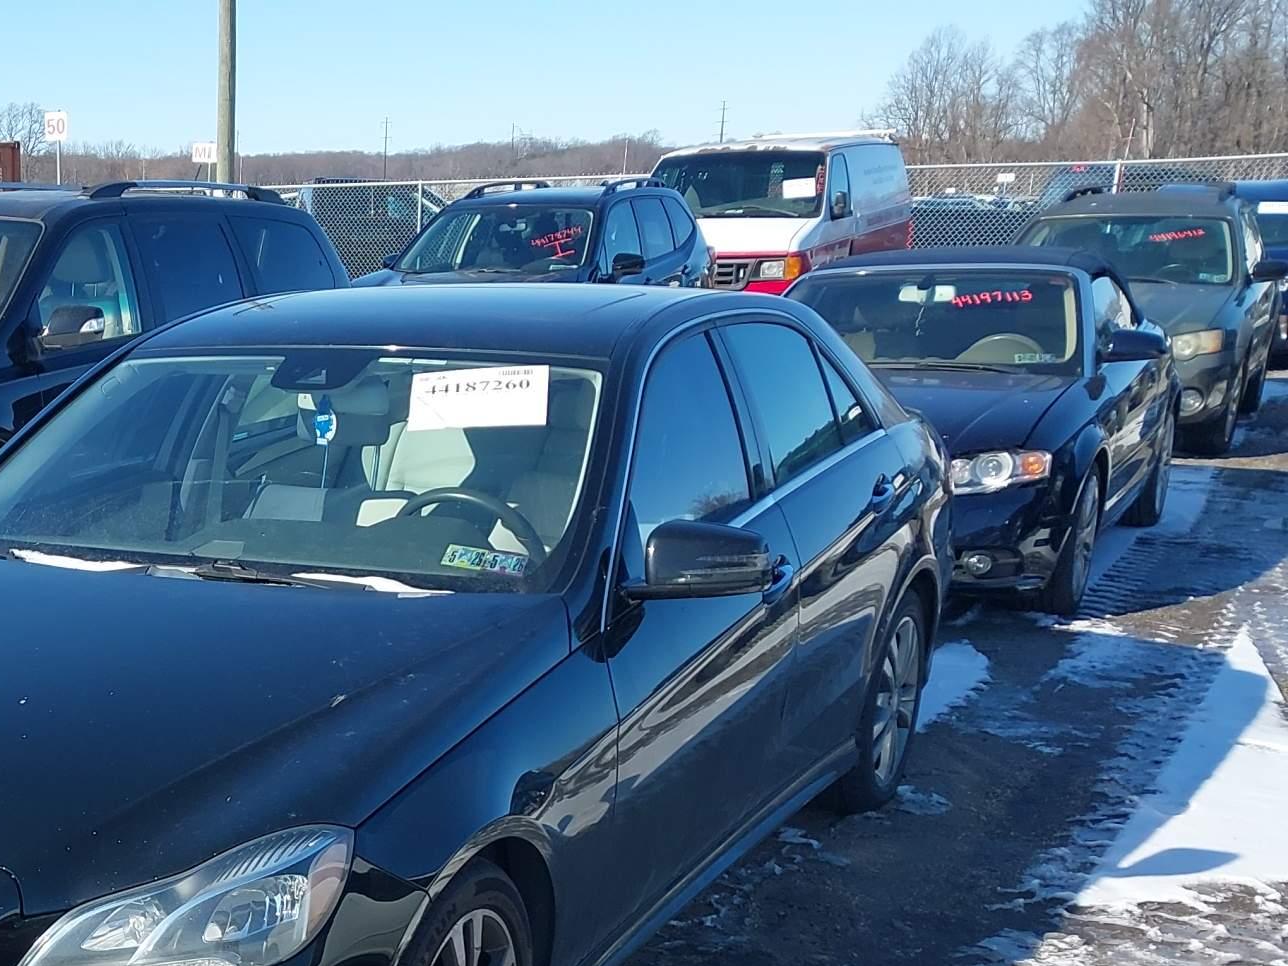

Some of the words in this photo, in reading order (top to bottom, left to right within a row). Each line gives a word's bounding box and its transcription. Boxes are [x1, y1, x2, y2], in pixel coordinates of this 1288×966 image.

[47, 118, 65, 135] 50
[952, 289, 1032, 308] 44197113
[424, 379, 531, 395] 44187260
